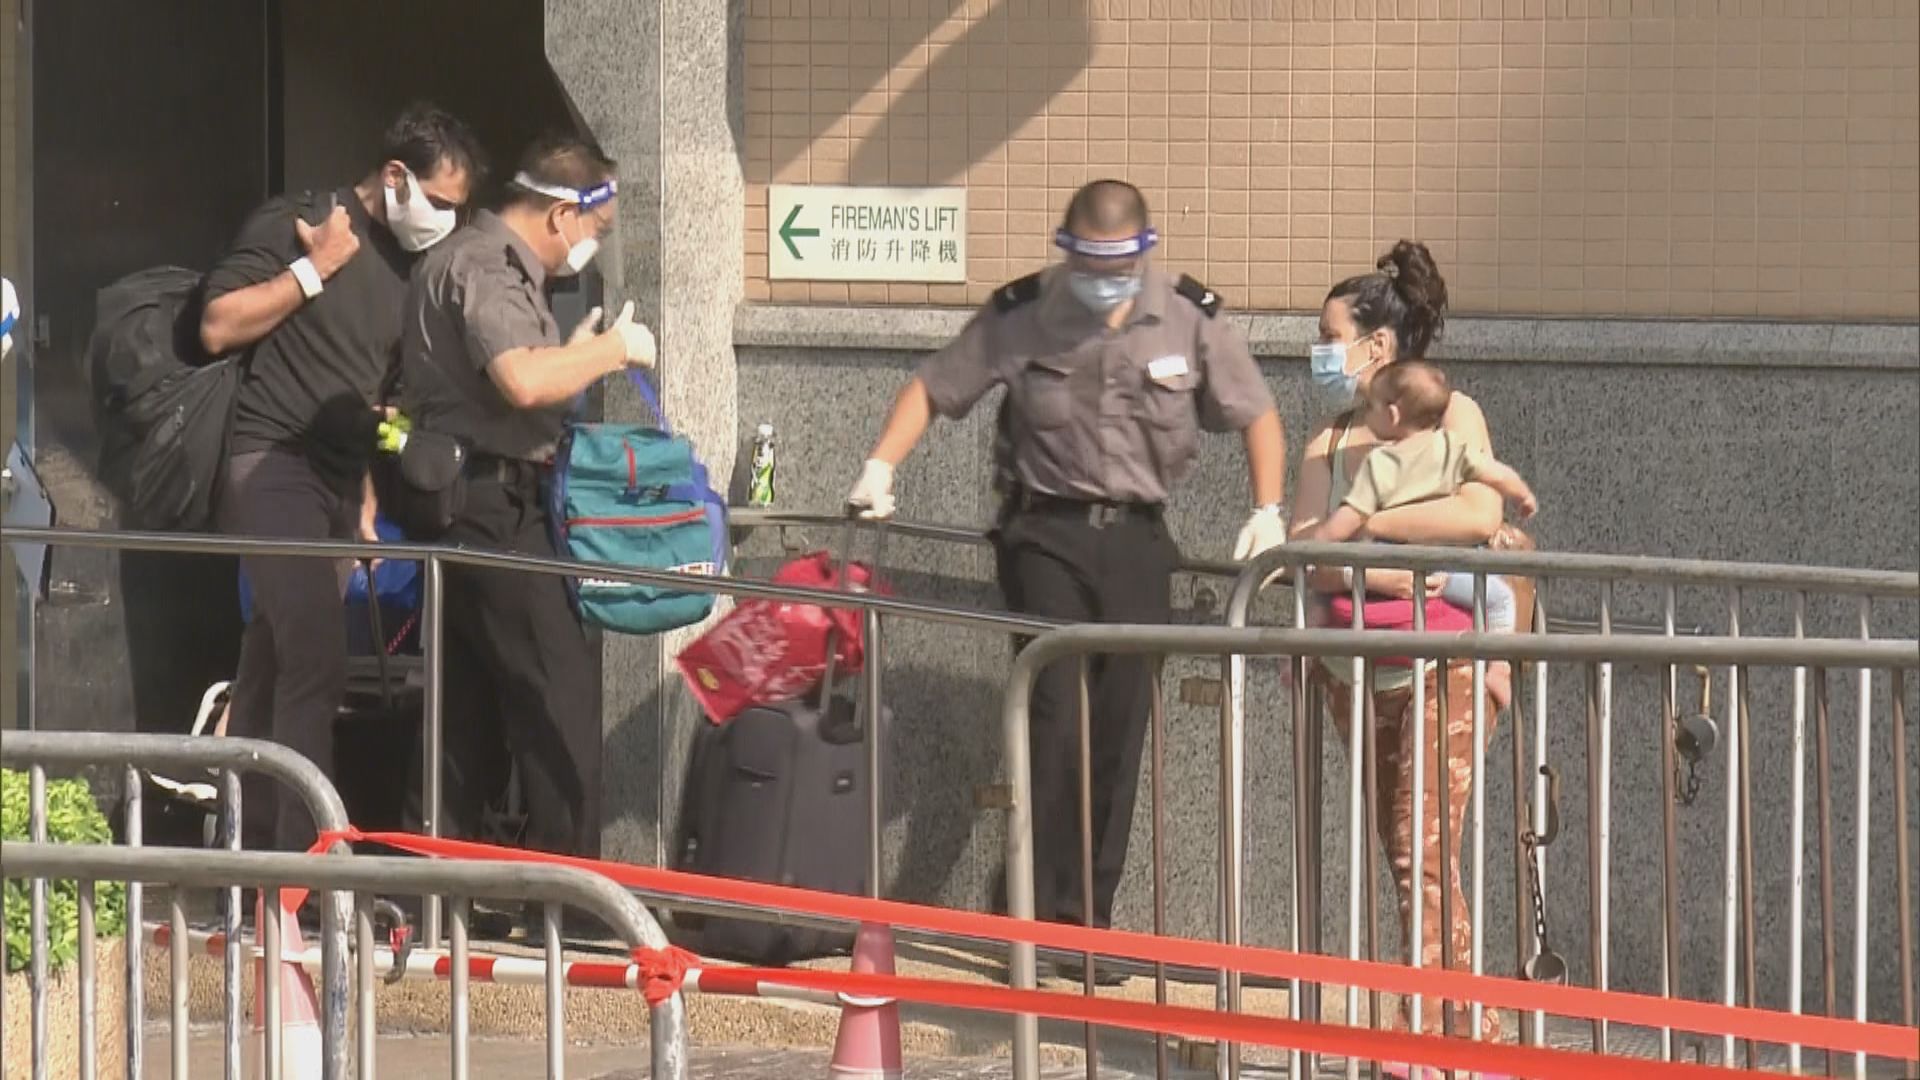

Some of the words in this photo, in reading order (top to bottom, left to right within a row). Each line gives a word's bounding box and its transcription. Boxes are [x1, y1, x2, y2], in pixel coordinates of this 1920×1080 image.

[831, 205, 920, 231] FIREMAN'S
[925, 206, 959, 232] LIFT
[831, 238, 958, 263] 消防升降機
